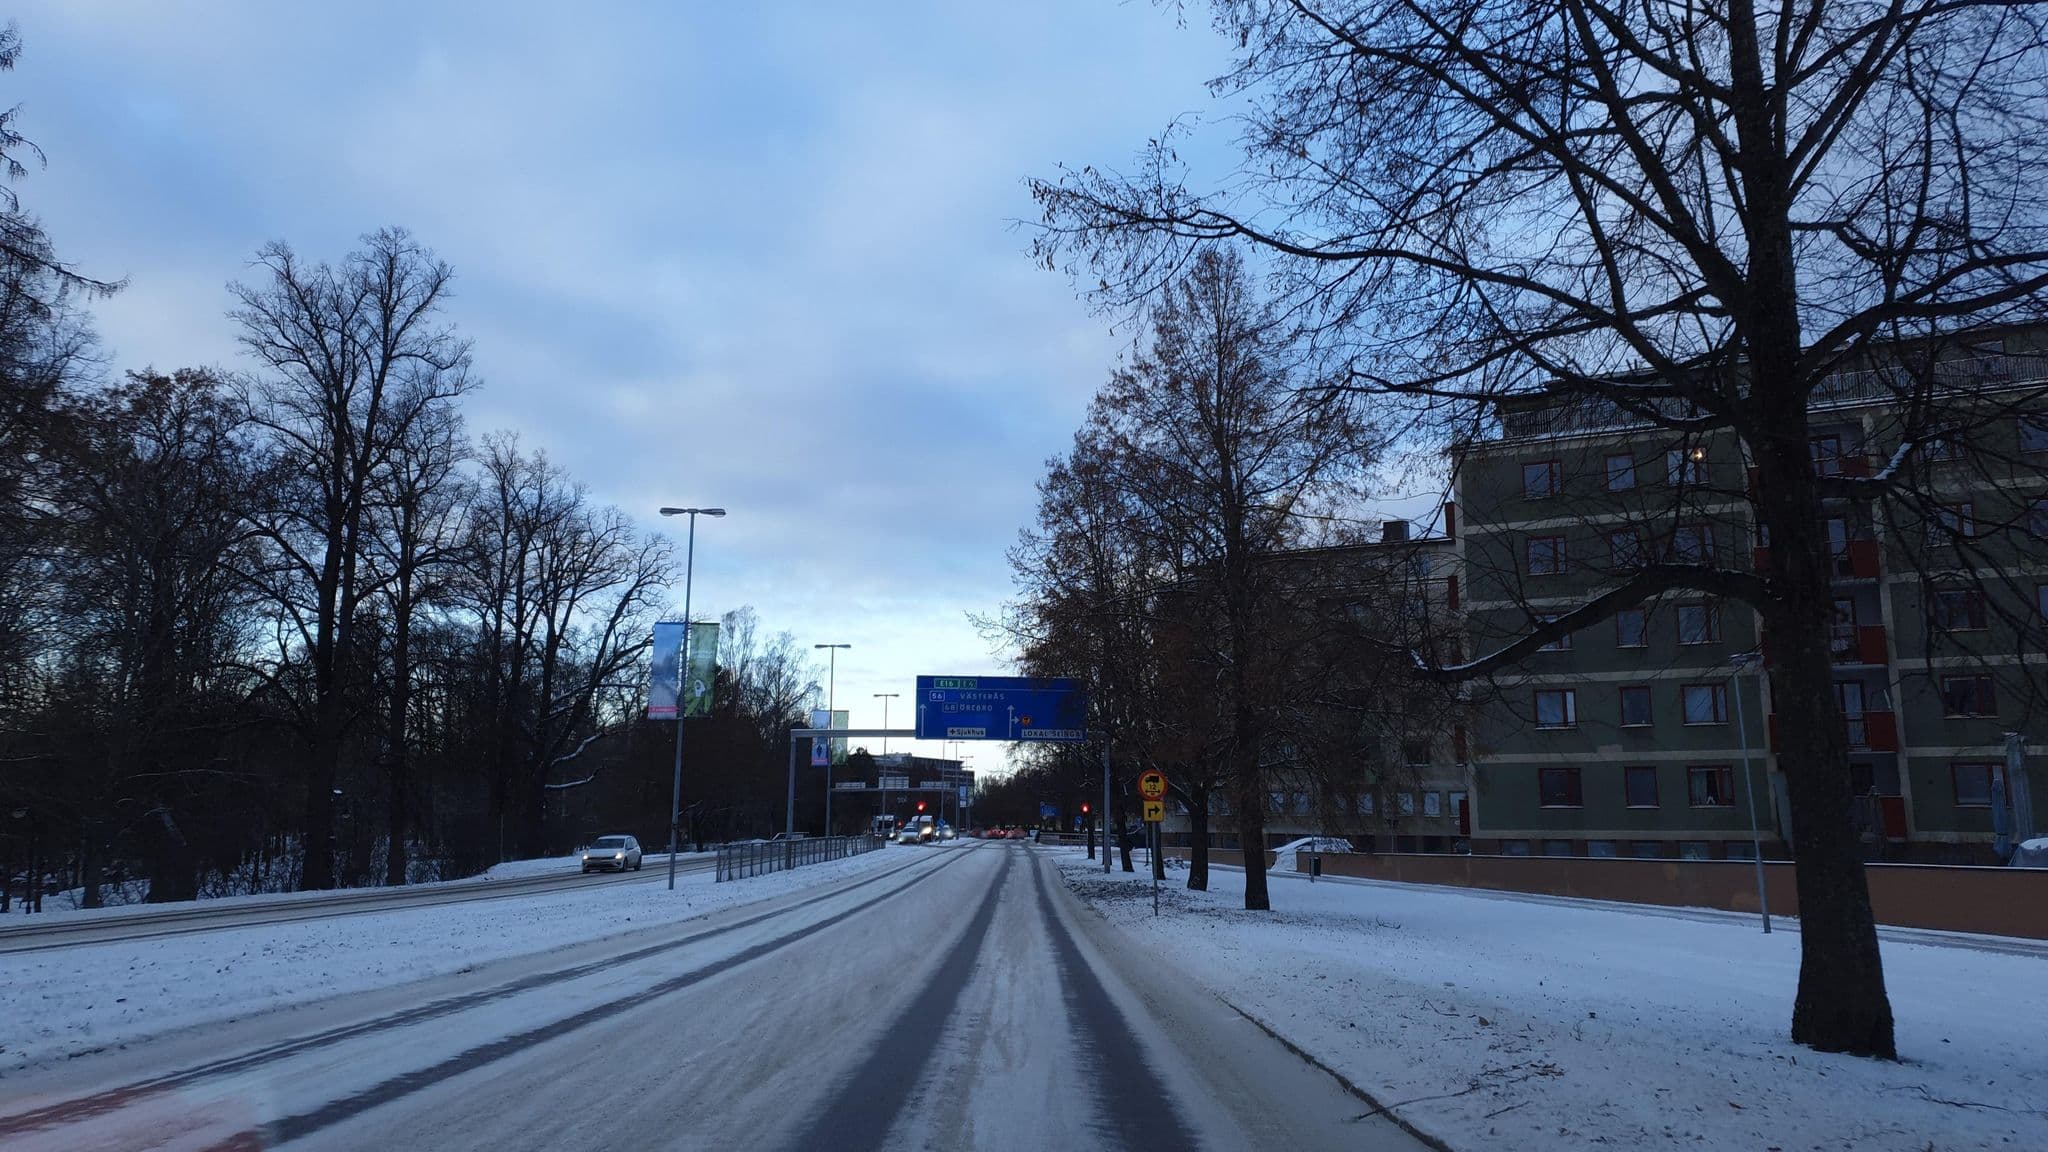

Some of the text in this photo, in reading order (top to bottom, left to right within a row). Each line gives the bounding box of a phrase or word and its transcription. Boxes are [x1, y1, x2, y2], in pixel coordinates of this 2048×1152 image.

[931, 692, 943, 700] 56
[960, 691, 1005, 701] VÄSTERÅS
[959, 703, 993, 712] ÖREBRO
[956, 728, 984, 736] Sjukhus
